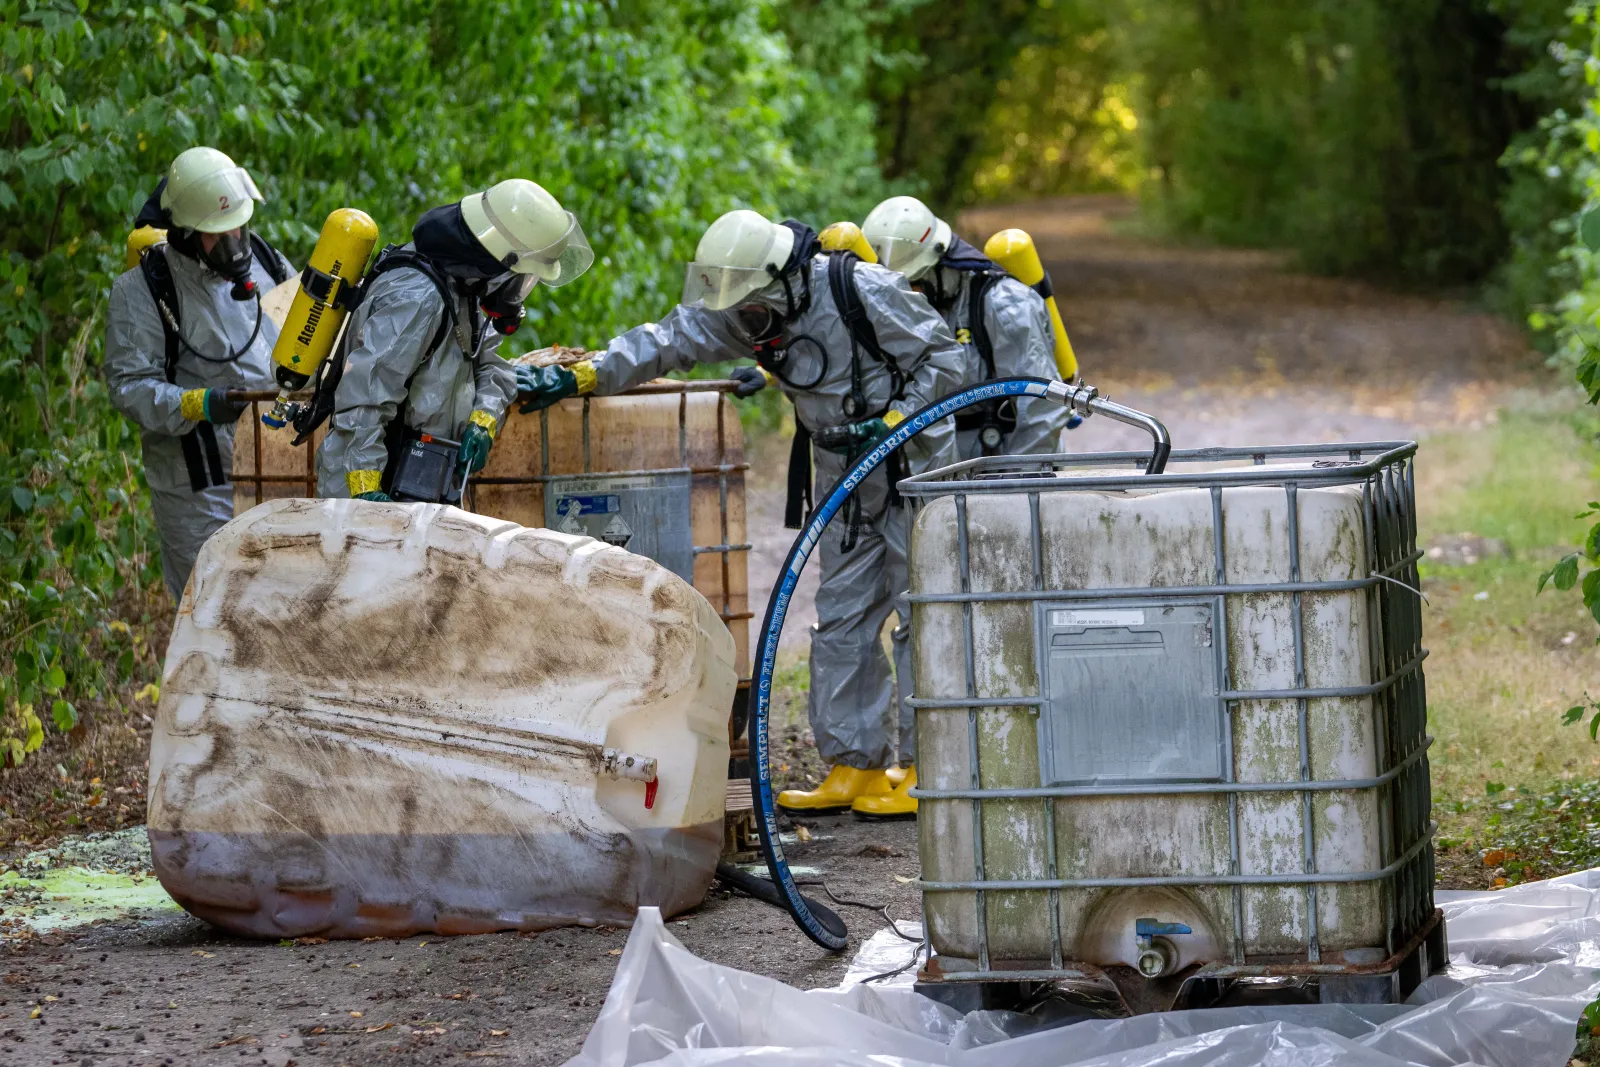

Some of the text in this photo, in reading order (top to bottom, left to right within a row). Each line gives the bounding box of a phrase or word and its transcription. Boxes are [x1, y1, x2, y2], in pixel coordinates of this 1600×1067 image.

[219, 196, 229, 210] 2
[297, 294, 328, 346] Atemlu
[329, 259, 342, 277] bar
[843, 426, 911, 492] SEMPERIT
[927, 383, 1005, 422] FLEXICHEM
